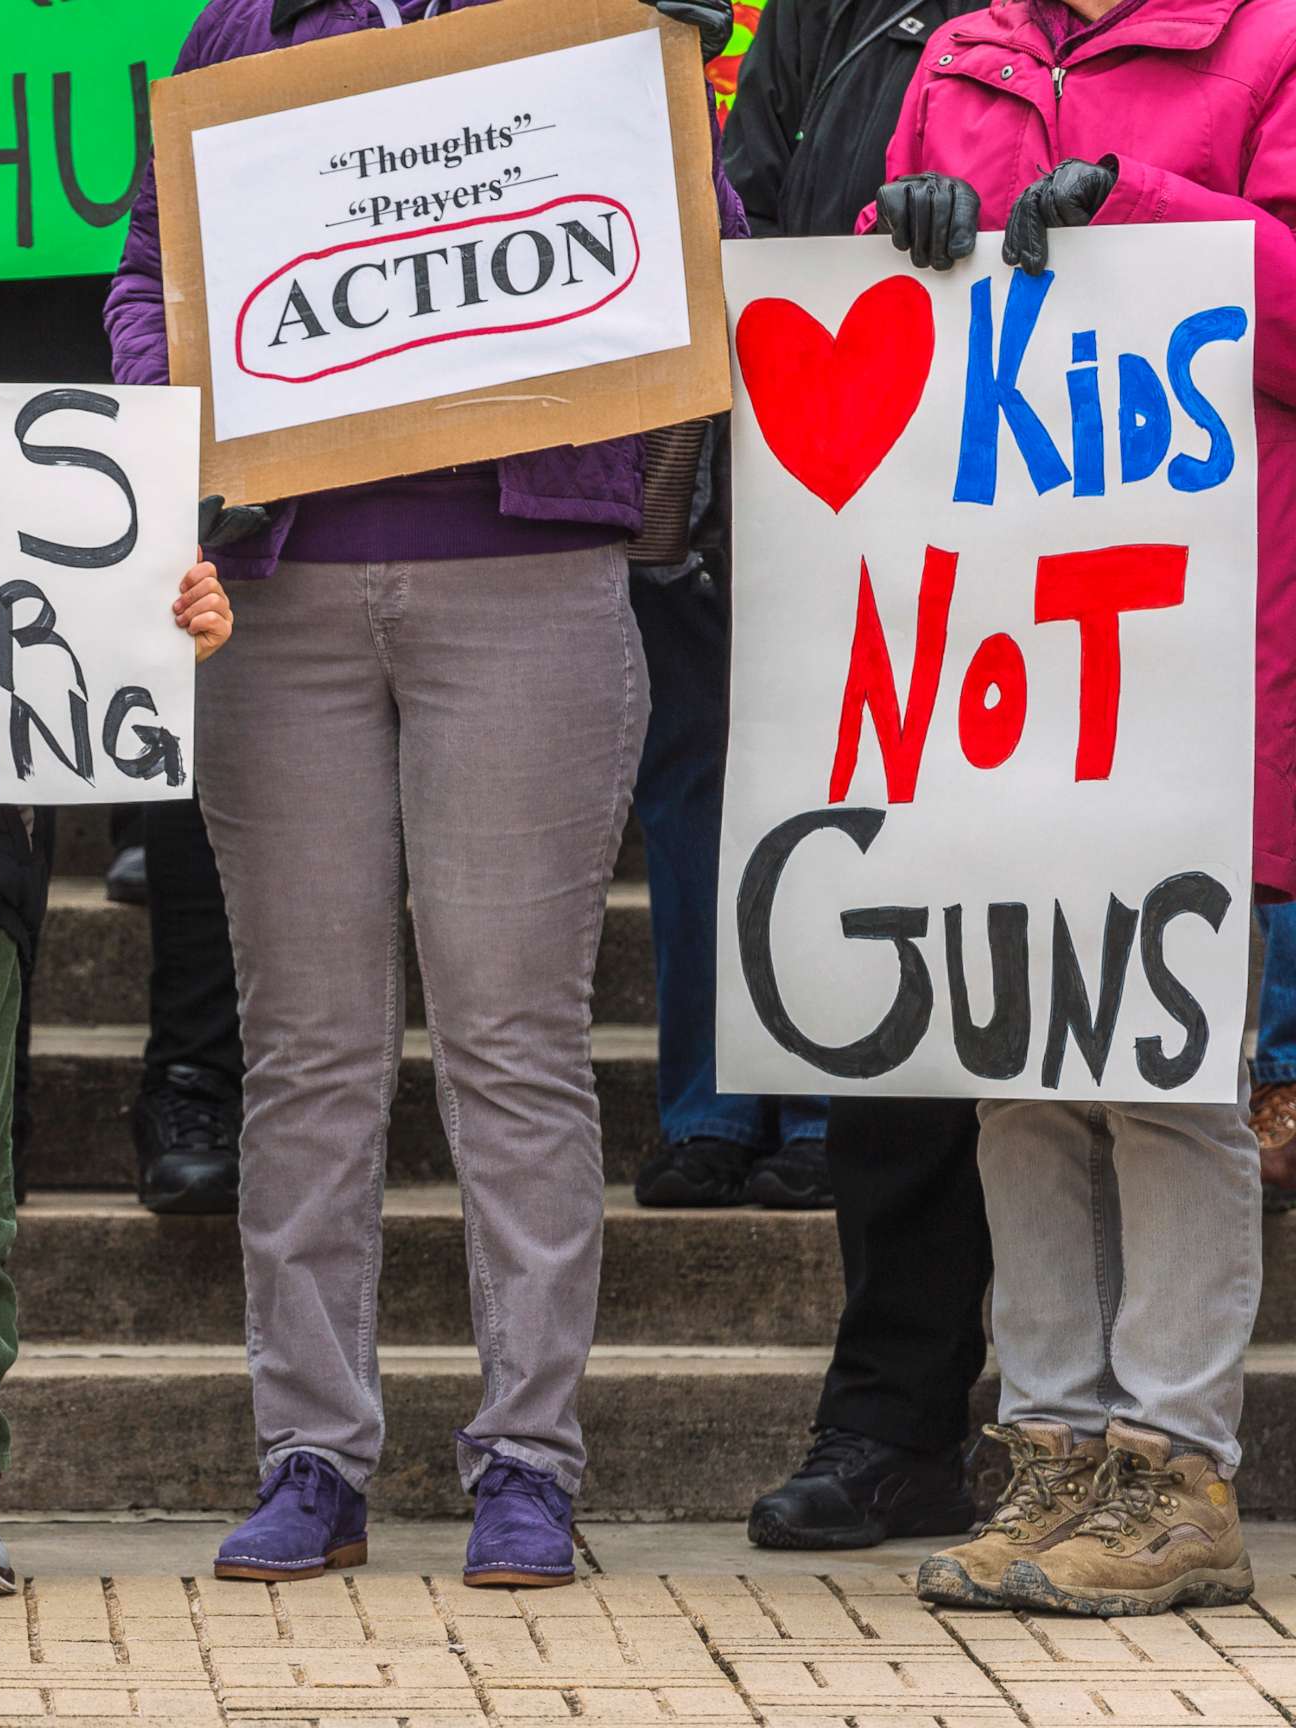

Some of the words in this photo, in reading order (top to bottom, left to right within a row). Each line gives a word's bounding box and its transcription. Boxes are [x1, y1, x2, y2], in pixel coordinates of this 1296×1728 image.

[330, 113, 532, 179] “Thoughts”
[348, 166, 522, 227] “Prayers”
[268, 211, 619, 347] ACTION
